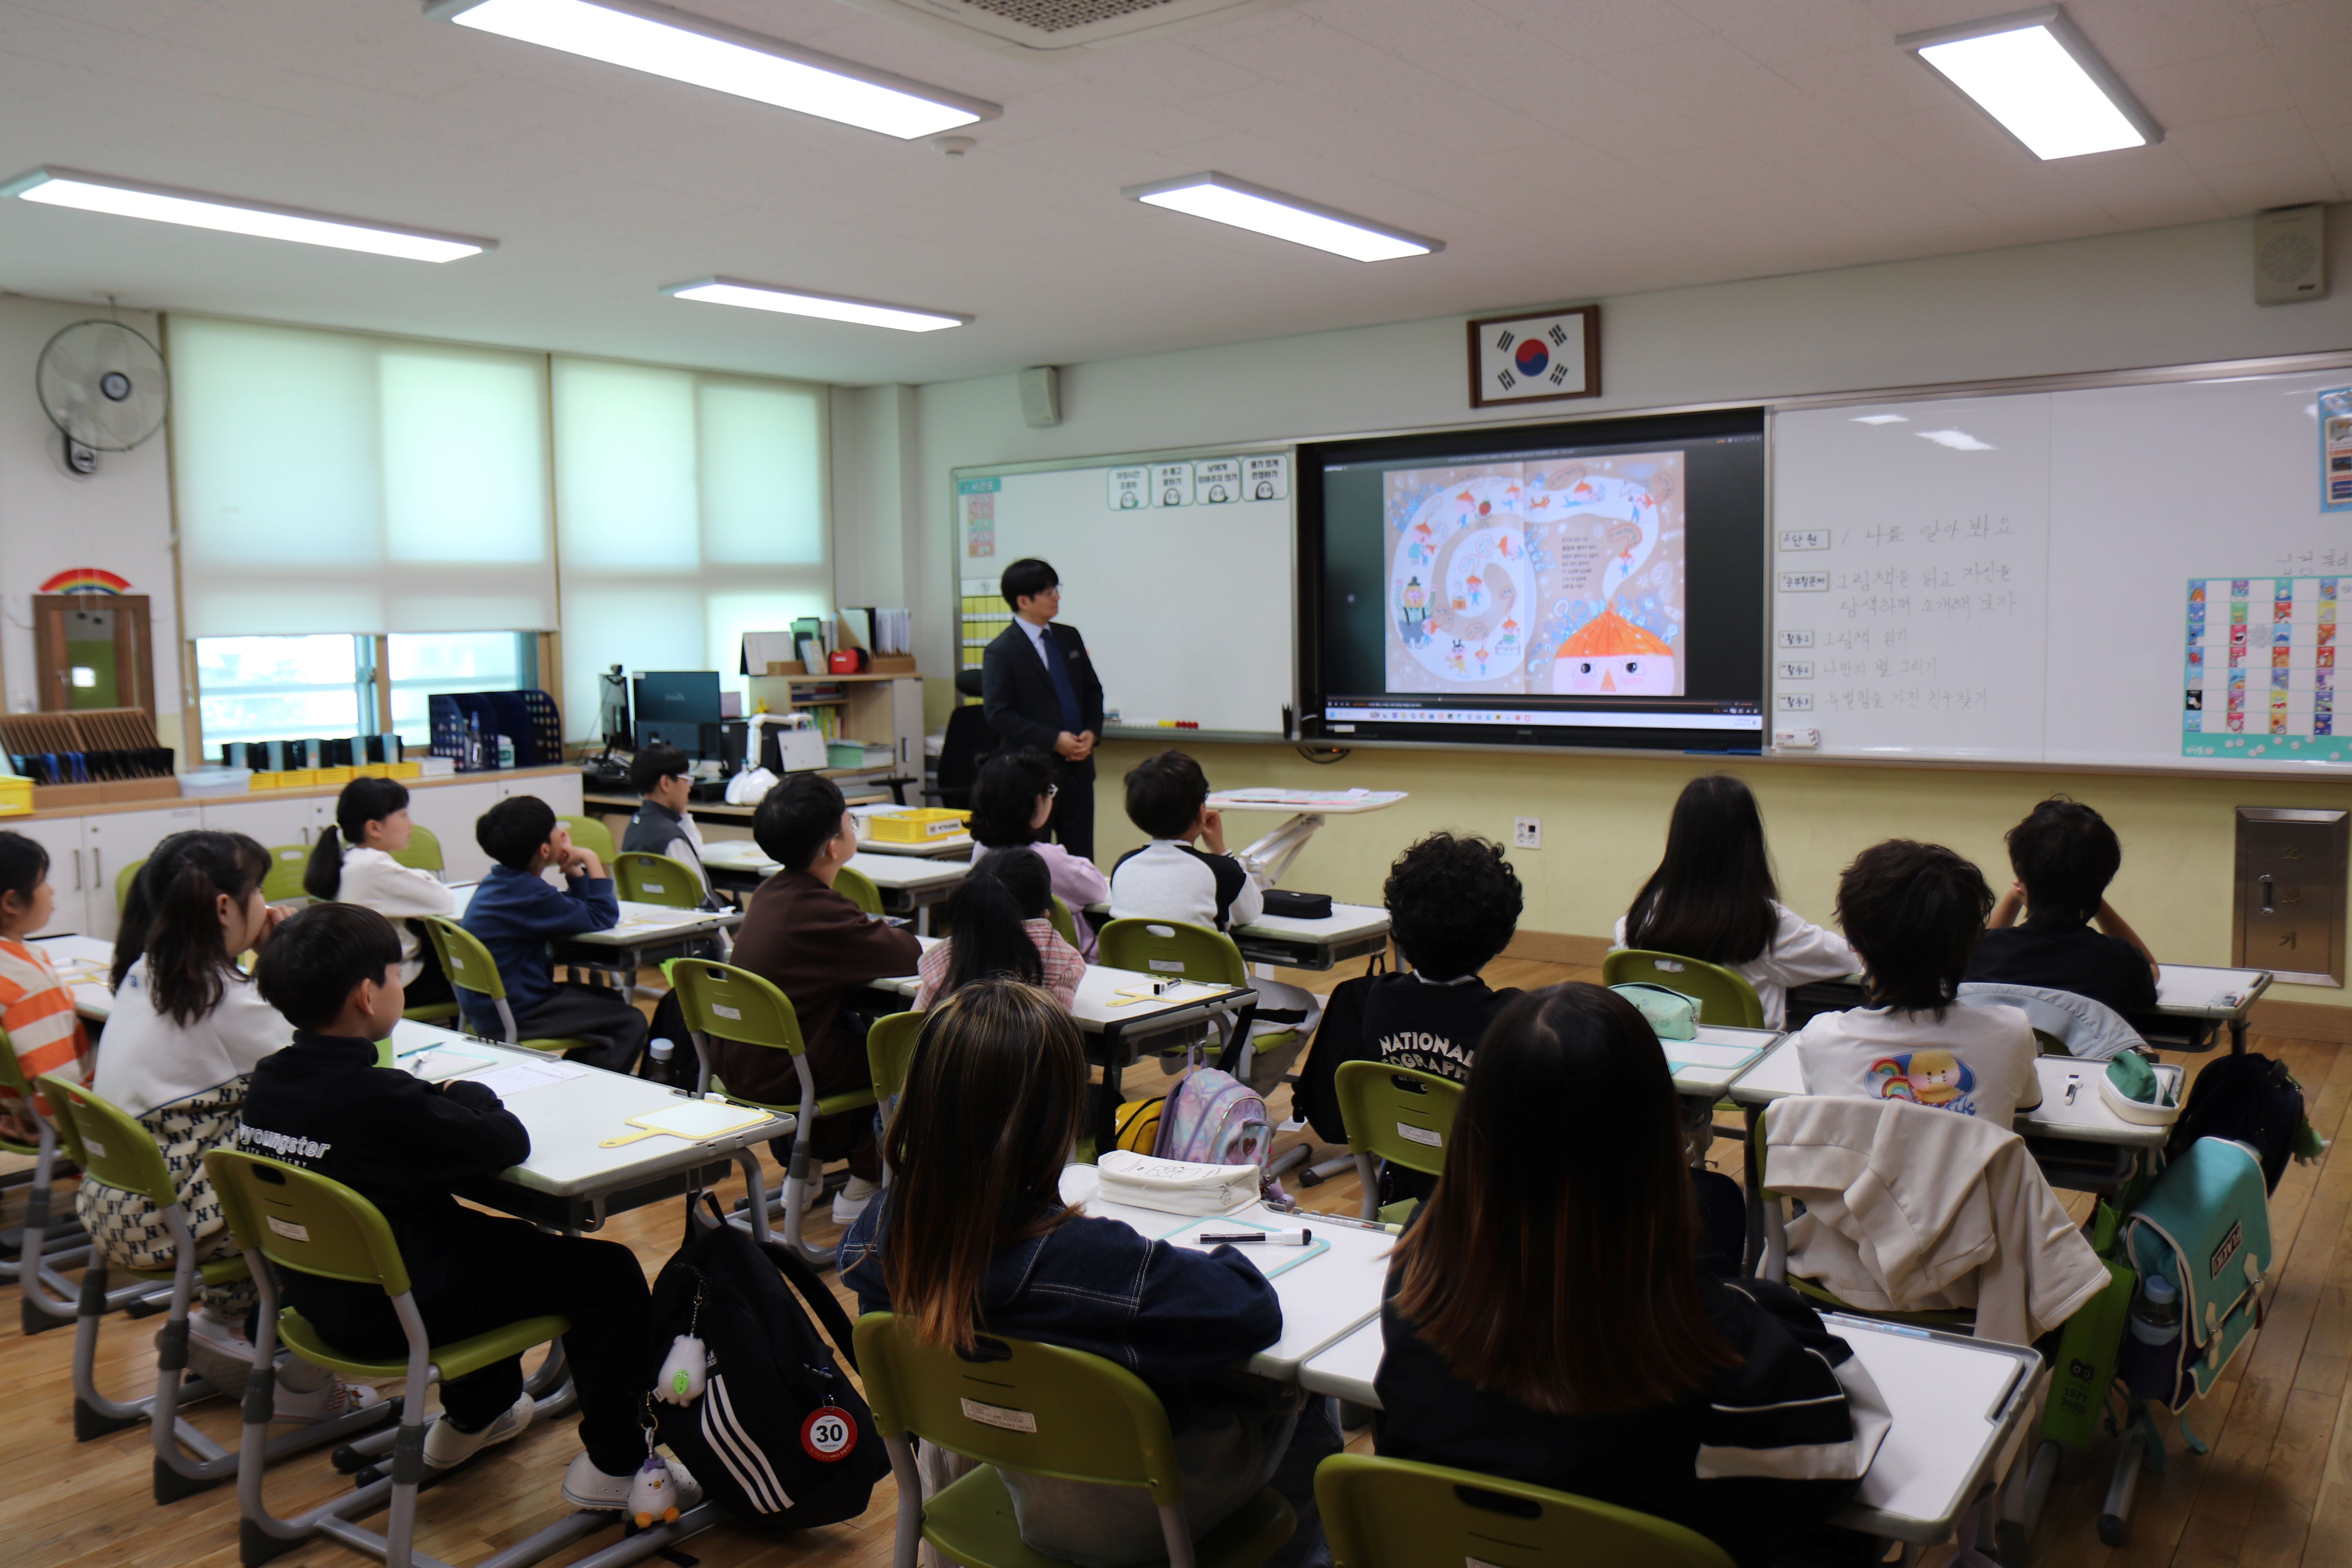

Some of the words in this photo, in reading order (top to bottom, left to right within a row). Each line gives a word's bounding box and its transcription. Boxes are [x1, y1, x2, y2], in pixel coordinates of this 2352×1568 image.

[1865, 524, 1904, 546] 나를
[1836, 566, 1911, 595] 그림책을
[1962, 561, 2011, 585] 자신을
[1822, 628, 1869, 649] 그림책
[1823, 659, 1866, 678] 나만의
[1378, 1032, 1475, 1068] NATIONAL
[816, 1424, 842, 1443] 30
